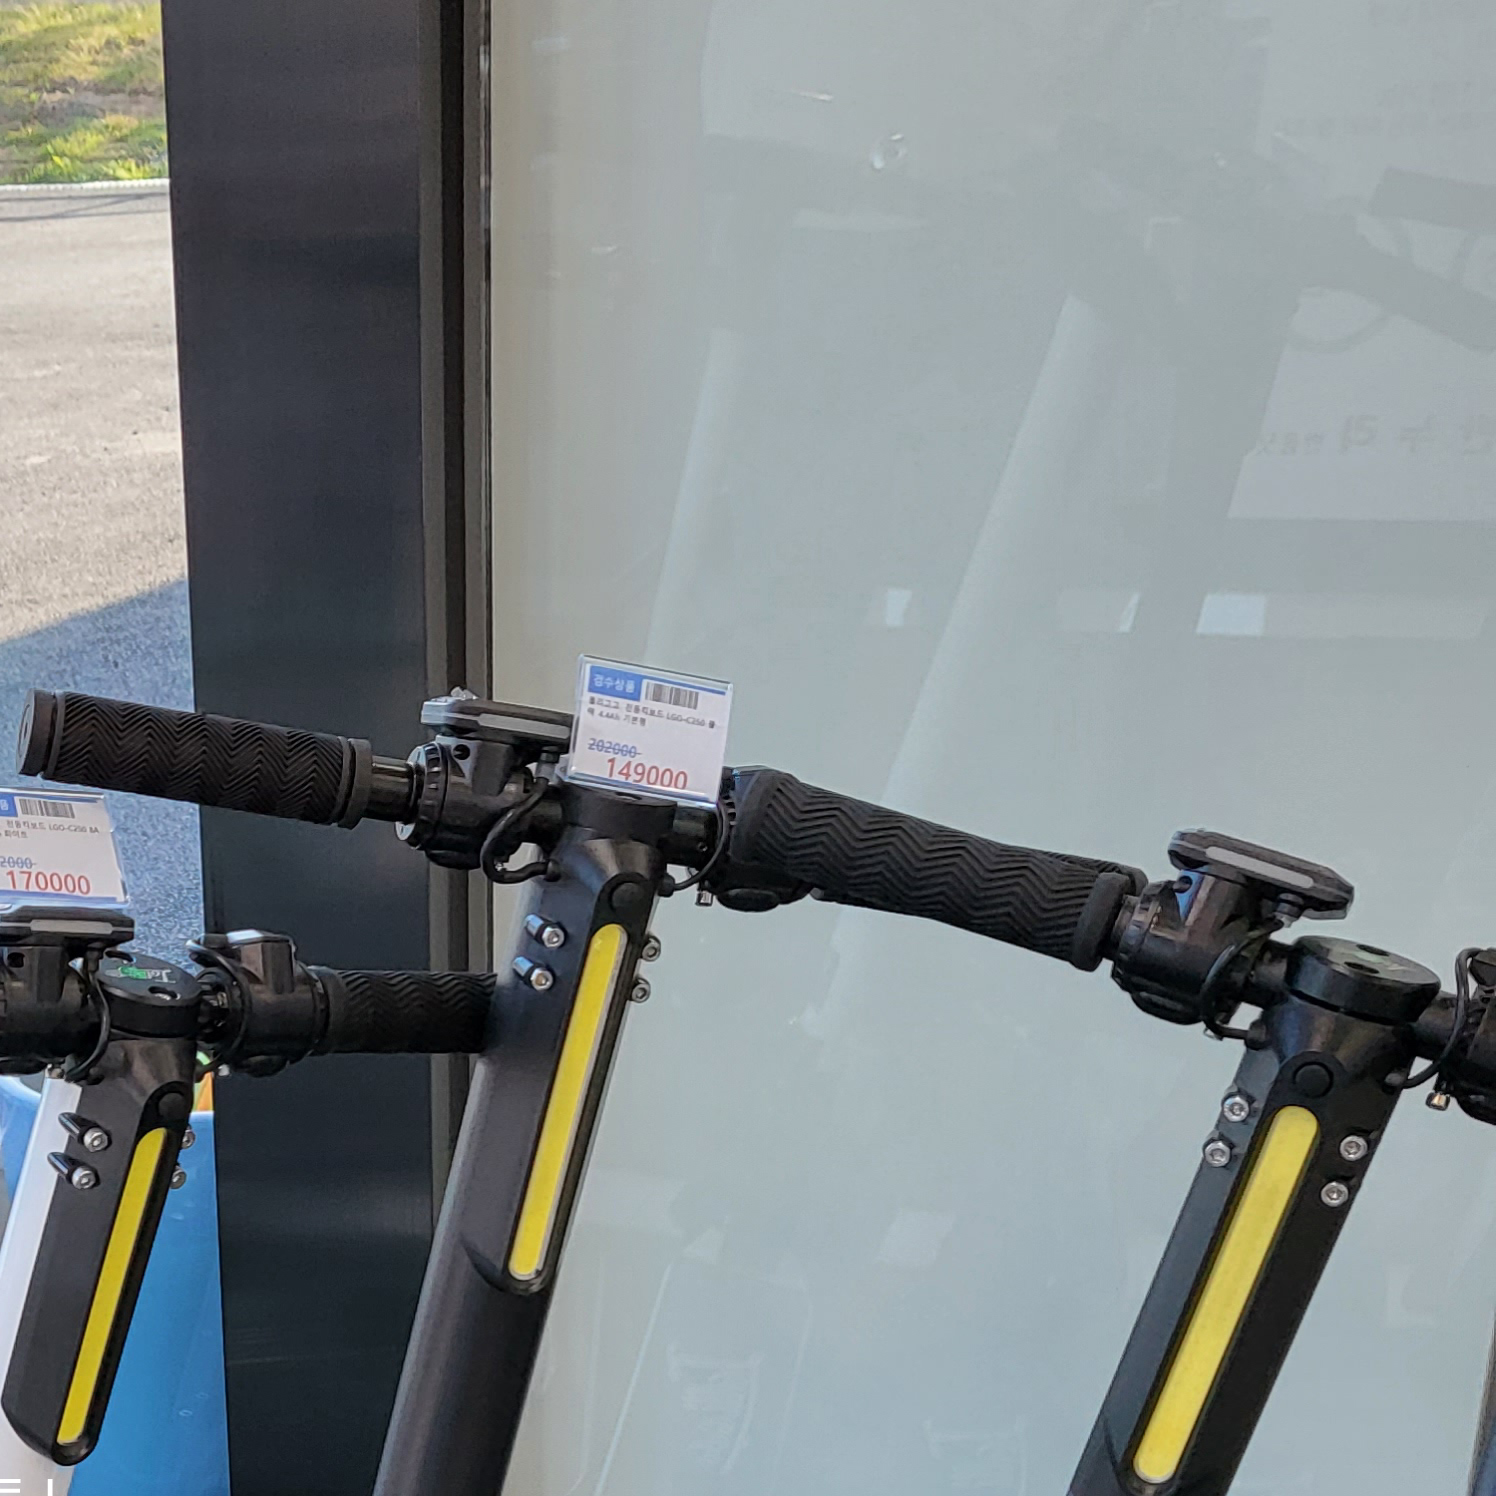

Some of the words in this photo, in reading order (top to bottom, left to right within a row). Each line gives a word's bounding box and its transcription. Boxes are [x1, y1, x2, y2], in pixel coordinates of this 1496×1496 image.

[593, 673, 636, 693] 검수상품
[607, 757, 689, 790] 149000
[6, 870, 91, 896] 170000
